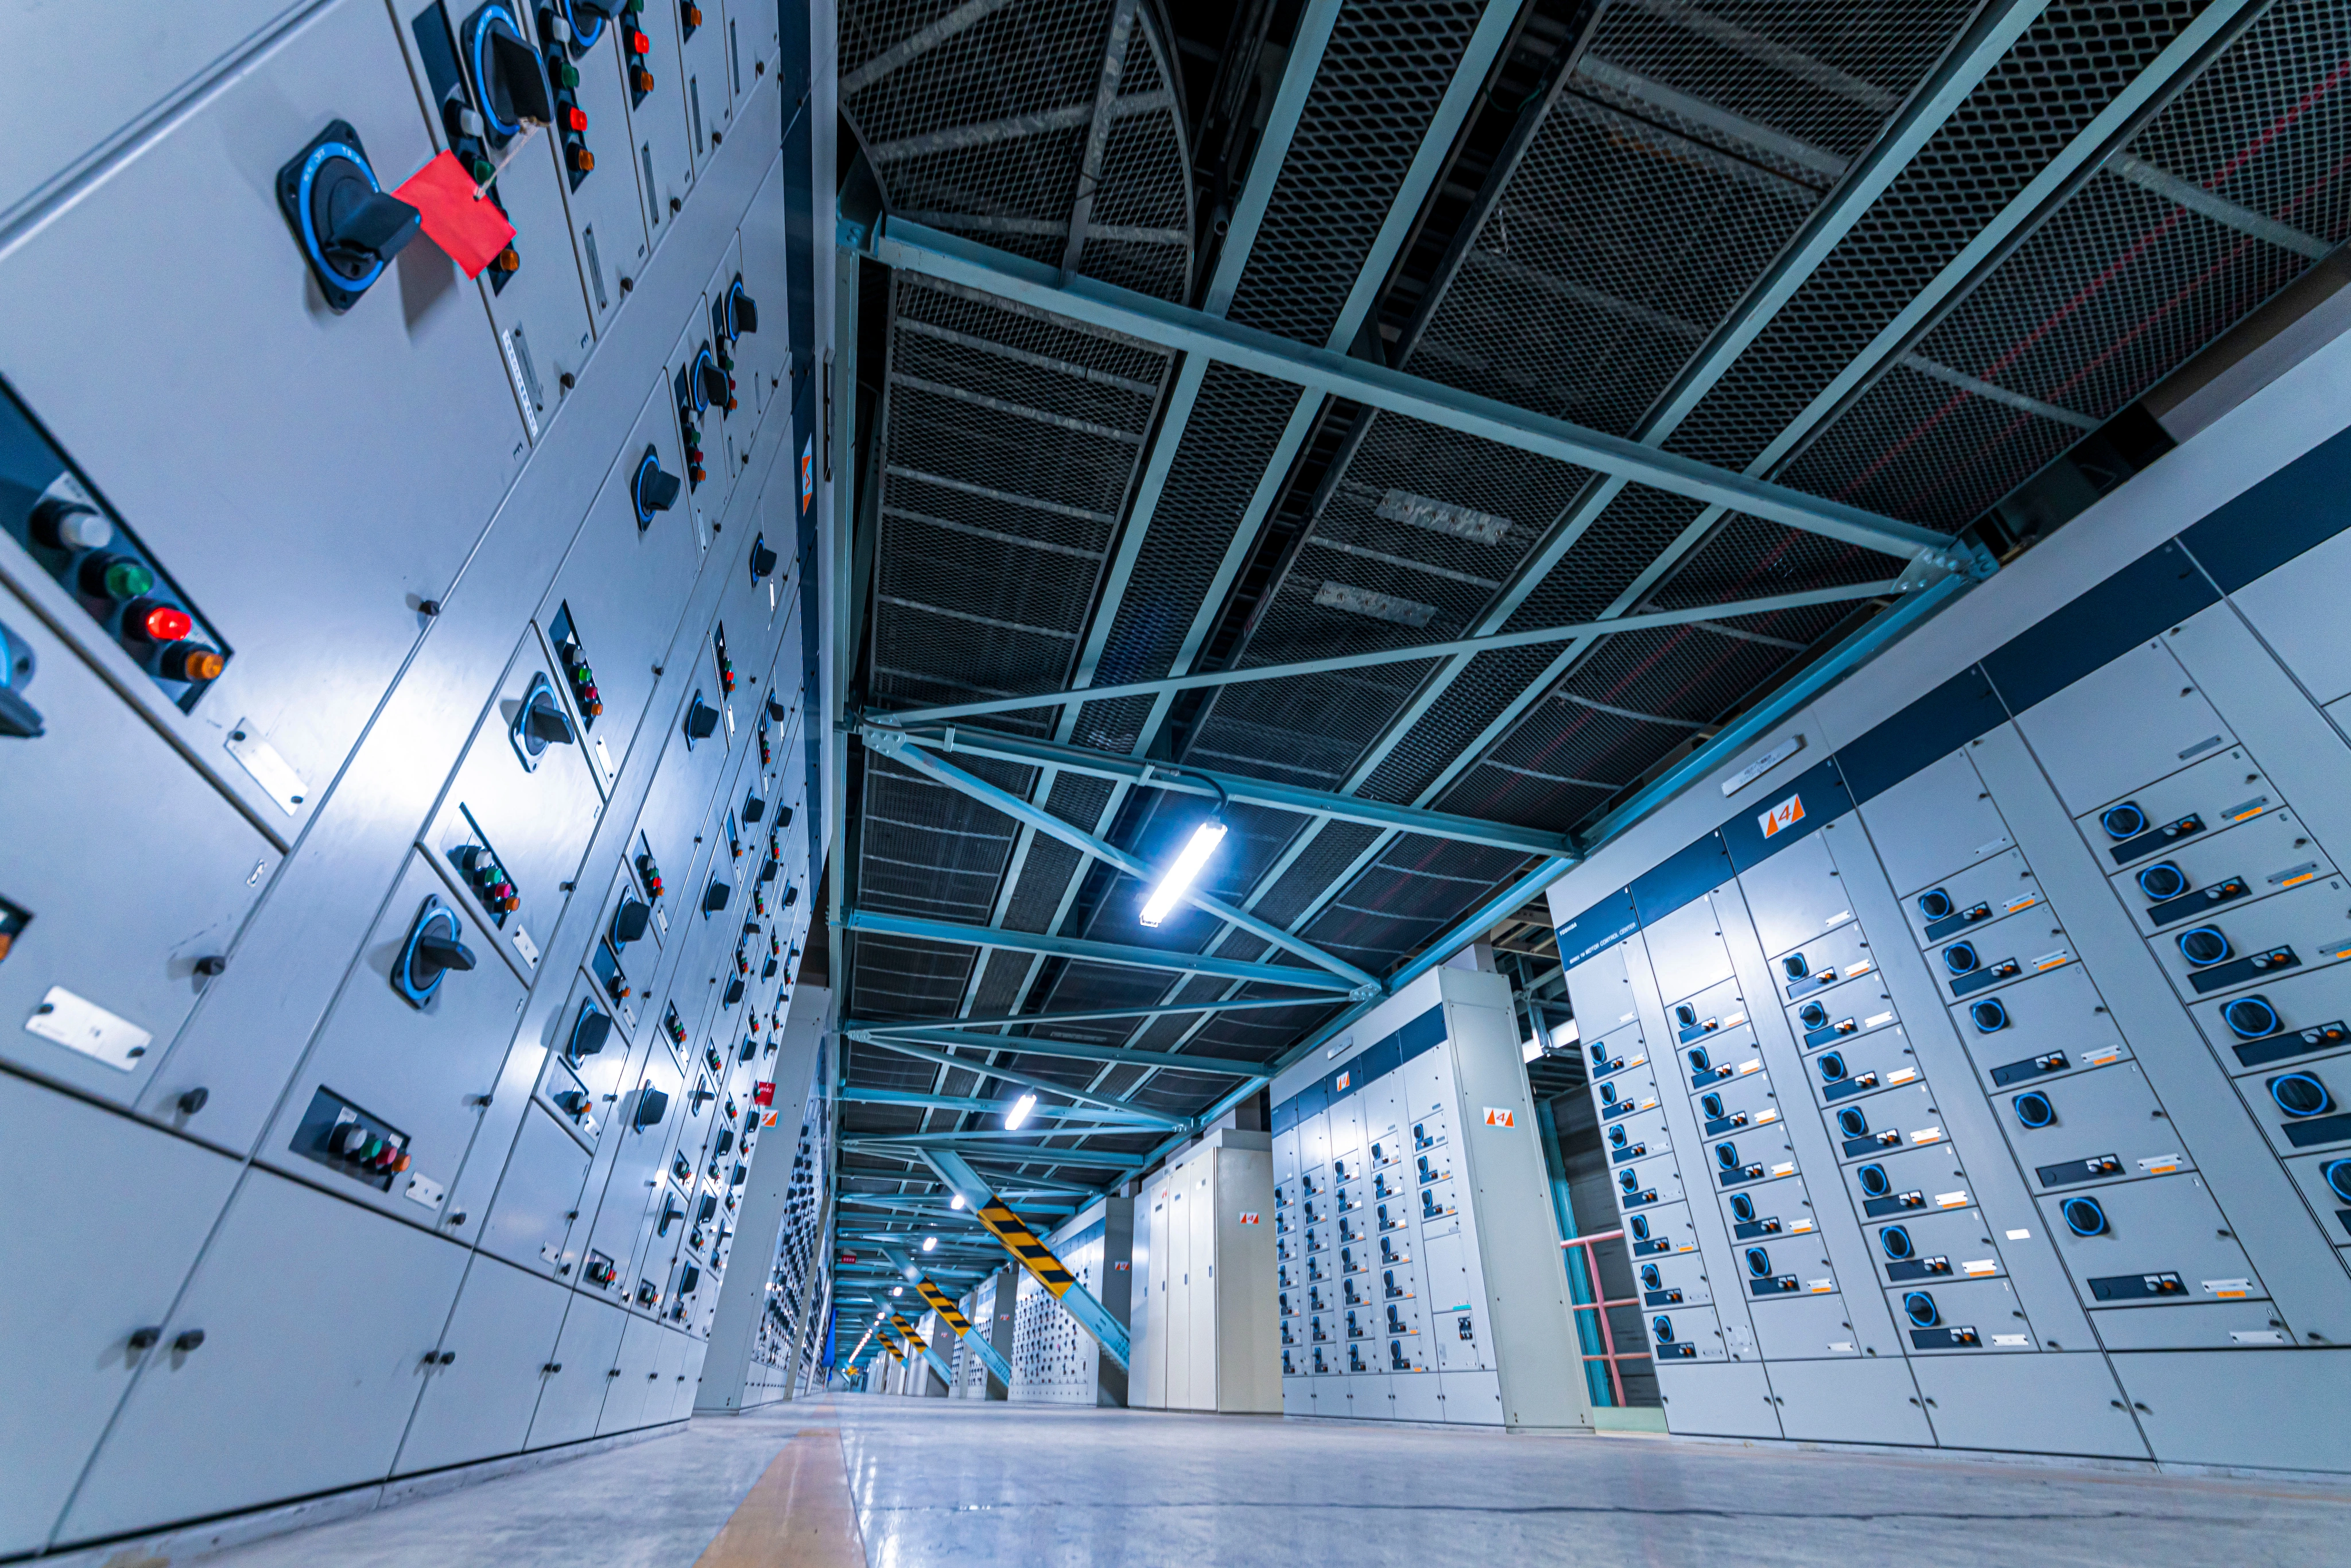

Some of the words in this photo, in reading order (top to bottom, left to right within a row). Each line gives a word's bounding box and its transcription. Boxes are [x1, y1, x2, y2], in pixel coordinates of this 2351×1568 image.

[580, 331, 589, 350] E
[805, 472, 811, 492] 4
[1778, 805, 1791, 822] 4
[1559, 922, 1577, 936] TOSHIBA
[1585, 942, 1600, 955] MOTOR
[1600, 932, 1619, 947] CONTROL
[1619, 922, 1636, 936] CENTER
[1342, 1076, 1346, 1084] 4
[1496, 1112, 1506, 1123] 4
